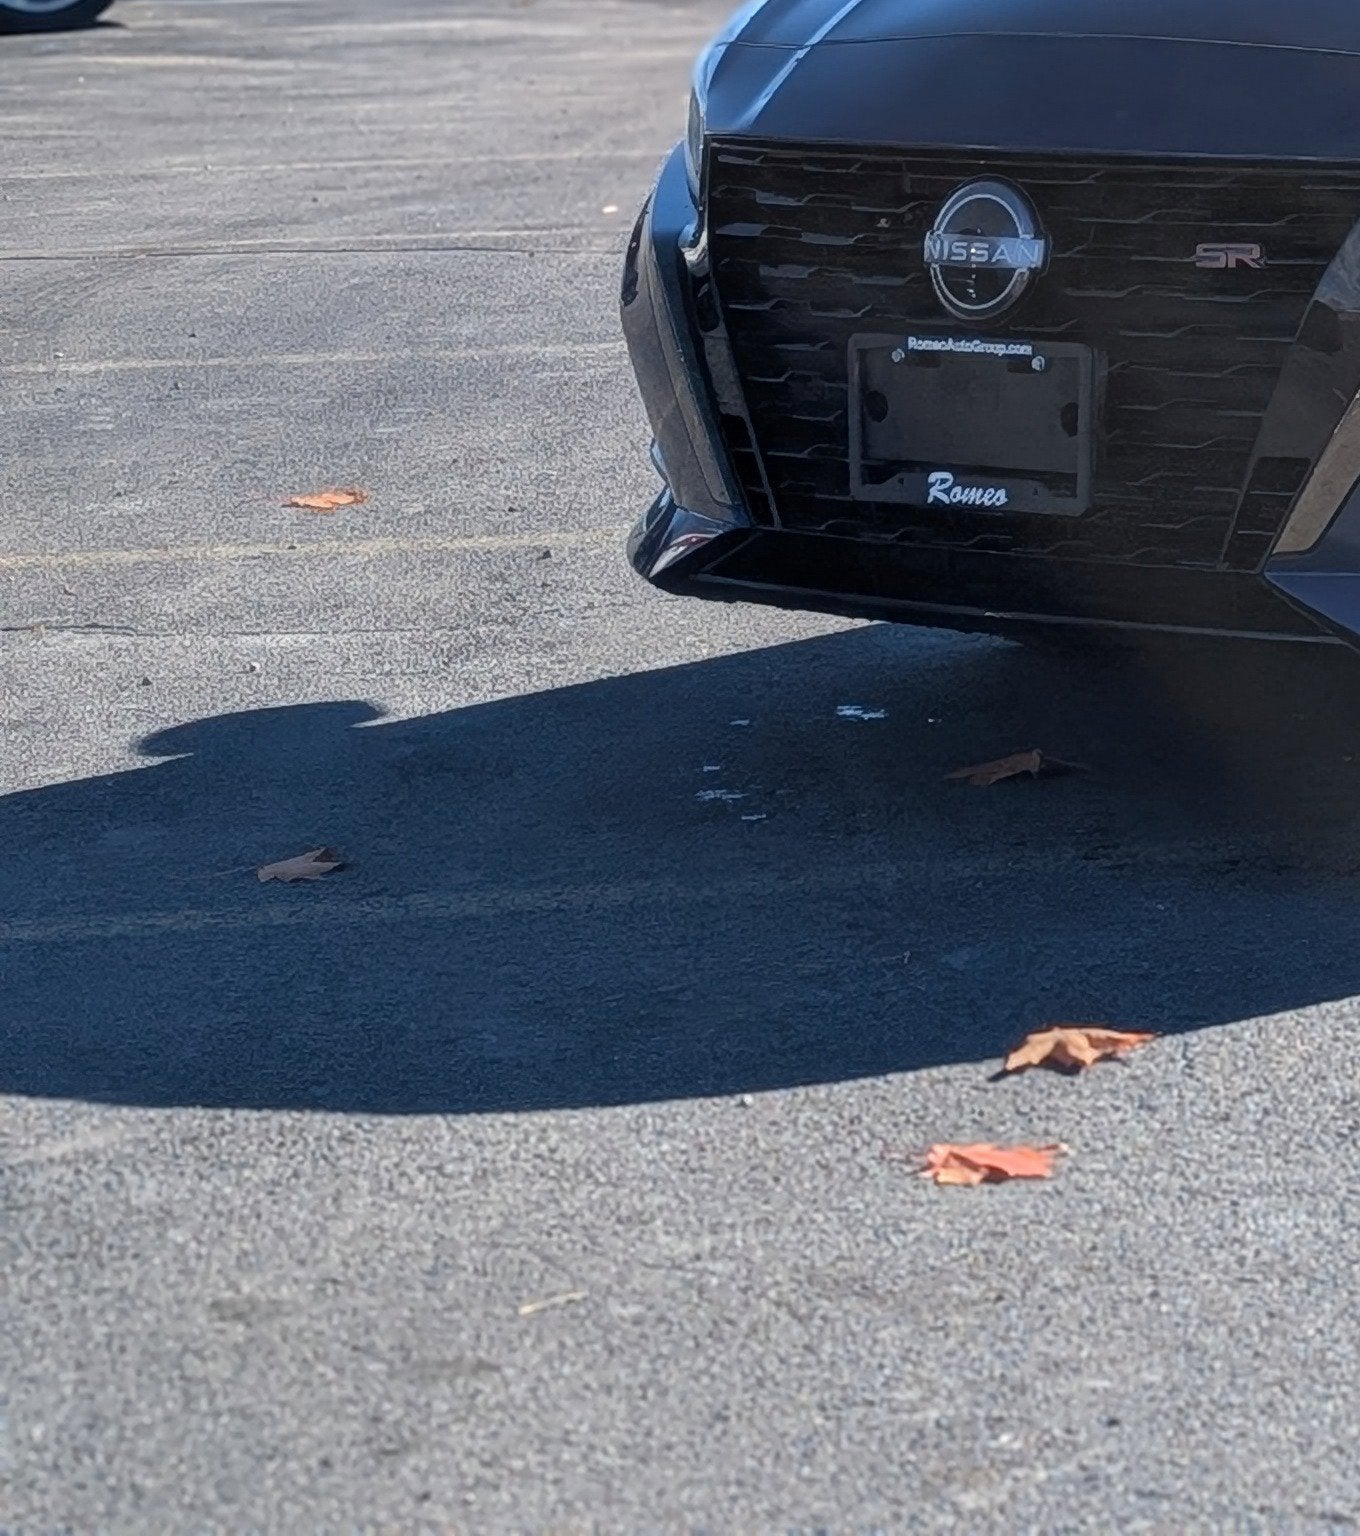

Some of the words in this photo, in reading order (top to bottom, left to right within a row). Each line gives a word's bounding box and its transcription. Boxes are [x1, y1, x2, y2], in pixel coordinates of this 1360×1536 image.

[924, 234, 1041, 266] NISSAN
[1195, 242, 1263, 269] SR
[926, 470, 1009, 506] Romeo
